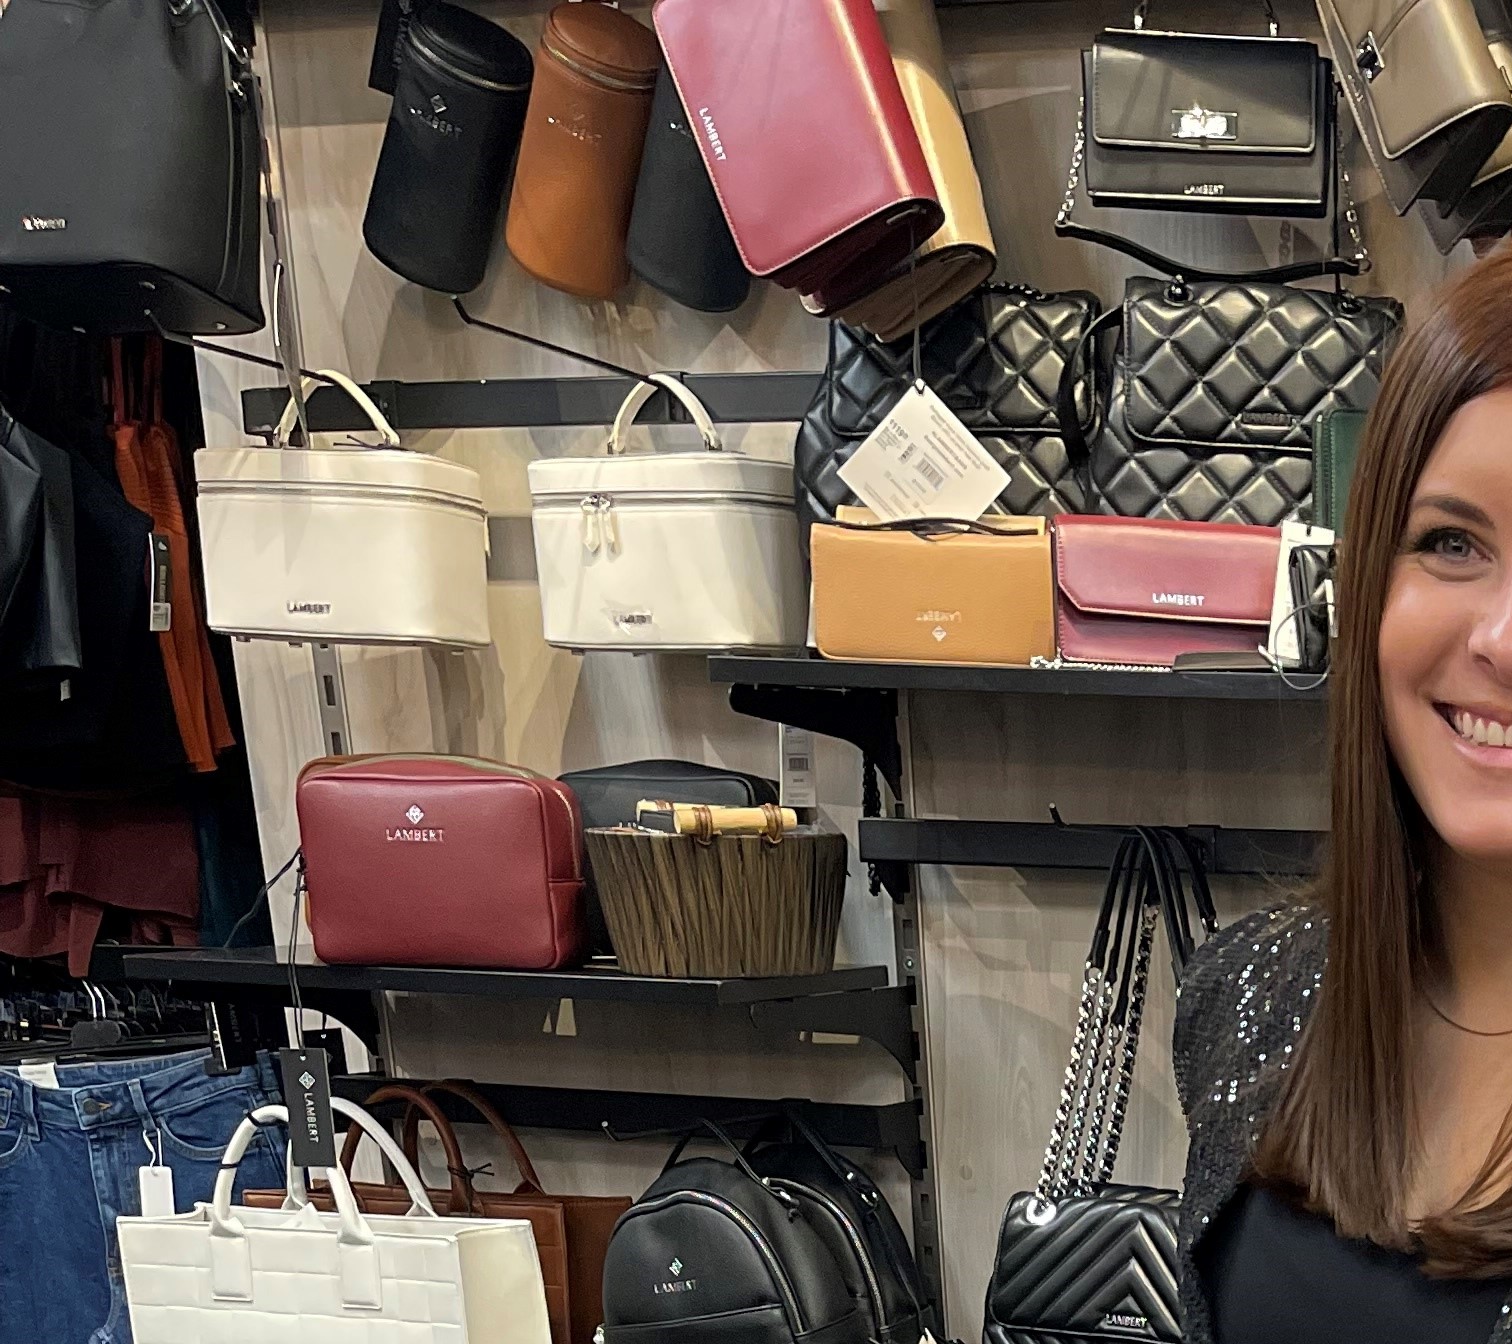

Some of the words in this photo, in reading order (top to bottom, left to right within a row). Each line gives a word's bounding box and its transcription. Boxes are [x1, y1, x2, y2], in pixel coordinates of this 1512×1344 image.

[698, 107, 727, 161] LAMBERT
[1151, 592, 1206, 607] LAMBERT
[385, 828, 444, 843] LAMBERT
[303, 1091, 320, 1144] LAMBERT
[1104, 1313, 1148, 1328] LAMBERT
